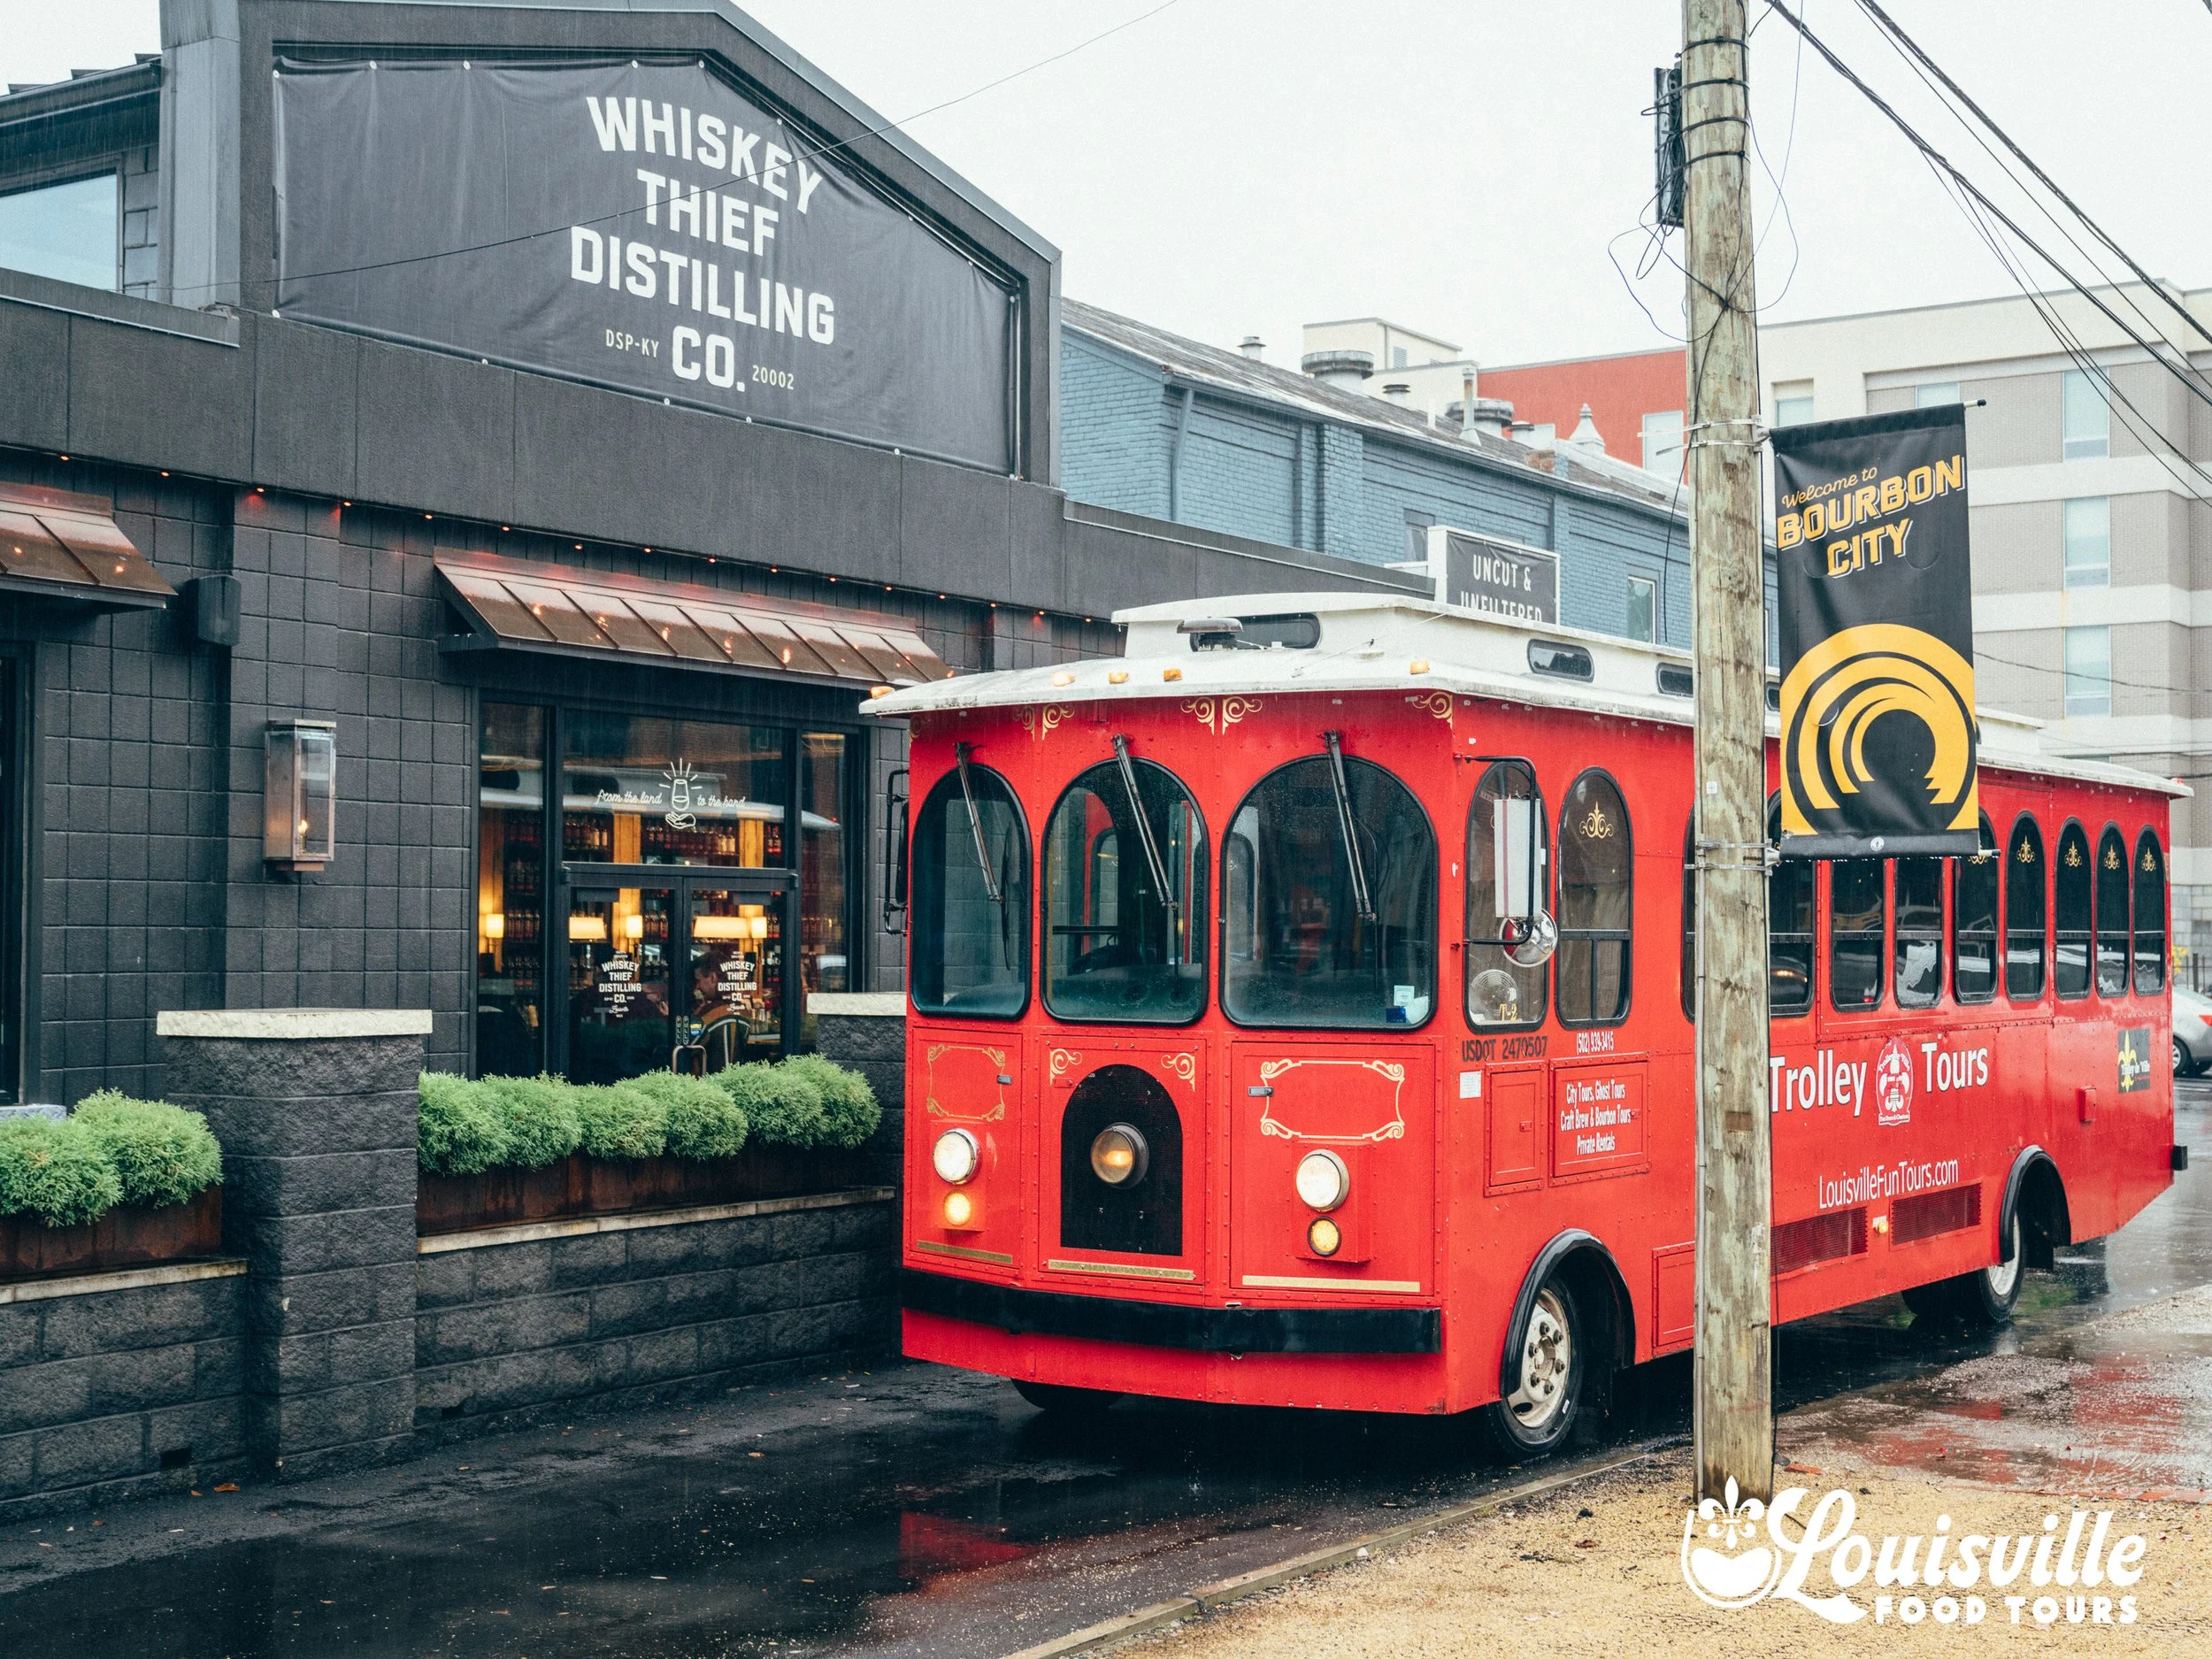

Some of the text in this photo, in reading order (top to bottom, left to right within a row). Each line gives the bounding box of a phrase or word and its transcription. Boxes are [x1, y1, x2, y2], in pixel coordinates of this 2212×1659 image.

[586, 96, 823, 215] WHISKEY
[637, 168, 780, 257] THIEF
[571, 226, 834, 345] DISTILLING
[605, 325, 795, 392] DSP-KY CO. 20002
[1777, 454, 1964, 551] BOURBON
[1781, 466, 1878, 509] Welcome to
[1827, 518, 1913, 580] CITY
[1473, 554, 1532, 592] UNCUT &
[596, 789, 746, 808] from the land to the hand
[602, 961, 640, 972] WHISKEY
[609, 972, 633, 981] THIEF
[720, 961, 756, 972] WHISKEY
[726, 972, 749, 980] THIEF
[599, 983, 641, 993] DISTILLING
[718, 982, 757, 992] DISTILLING
[1462, 1036, 1548, 1063] USDOT 2470507
[1577, 1033, 1590, 1056] (502)
[1566, 1079, 1625, 1110] City Tours, Ghost Tours
[1770, 1048, 1867, 1118] Trolley
[1921, 1041, 1989, 1093] Tours
[1560, 1103, 1632, 1132] Craft Brew & Bourbon Tours
[1577, 1131, 1616, 1156] Private Rentals
[1819, 1159, 1959, 1210] LouisvilleFunTours.com
